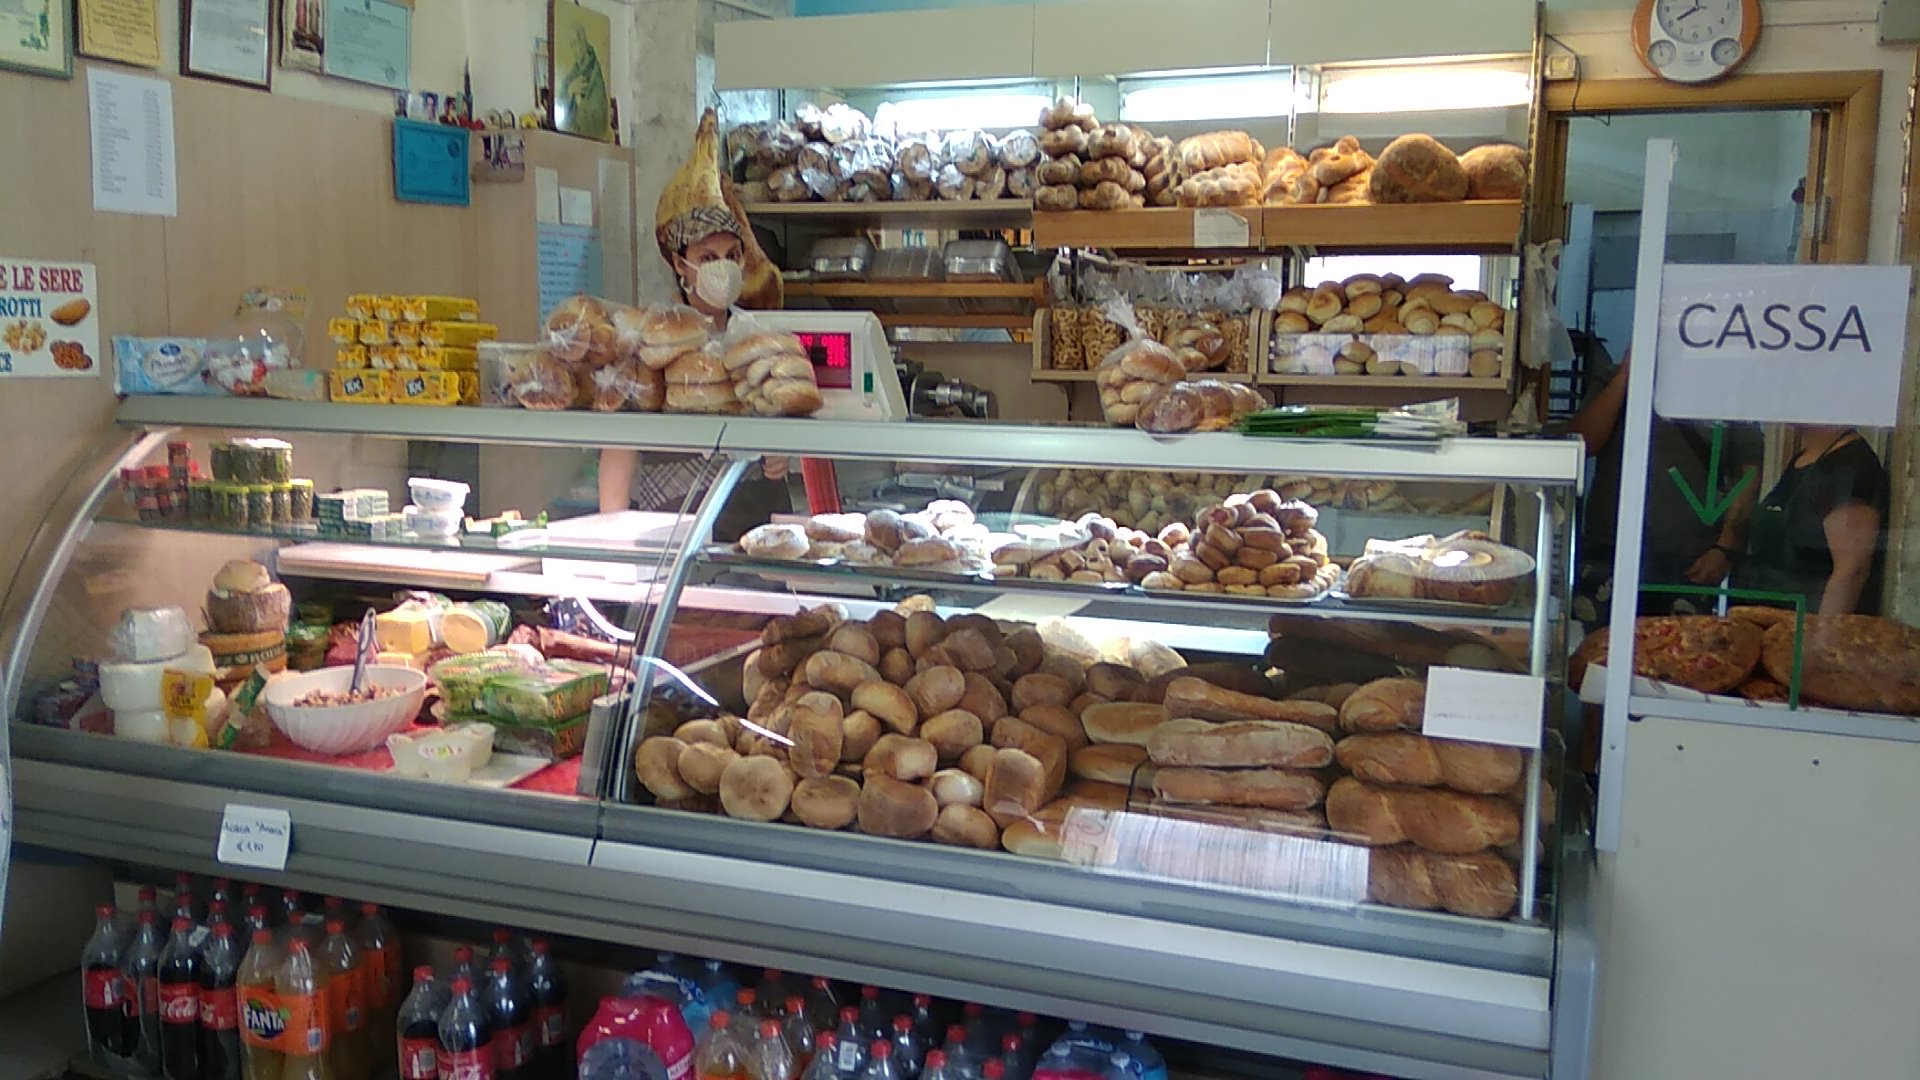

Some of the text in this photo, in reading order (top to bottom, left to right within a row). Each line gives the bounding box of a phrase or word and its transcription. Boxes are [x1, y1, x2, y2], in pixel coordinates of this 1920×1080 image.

[12, 266, 35, 291] LE
[39, 267, 84, 293] SERE
[1678, 302, 1872, 353] CASSA
[243, 1004, 285, 1031] FANTA
